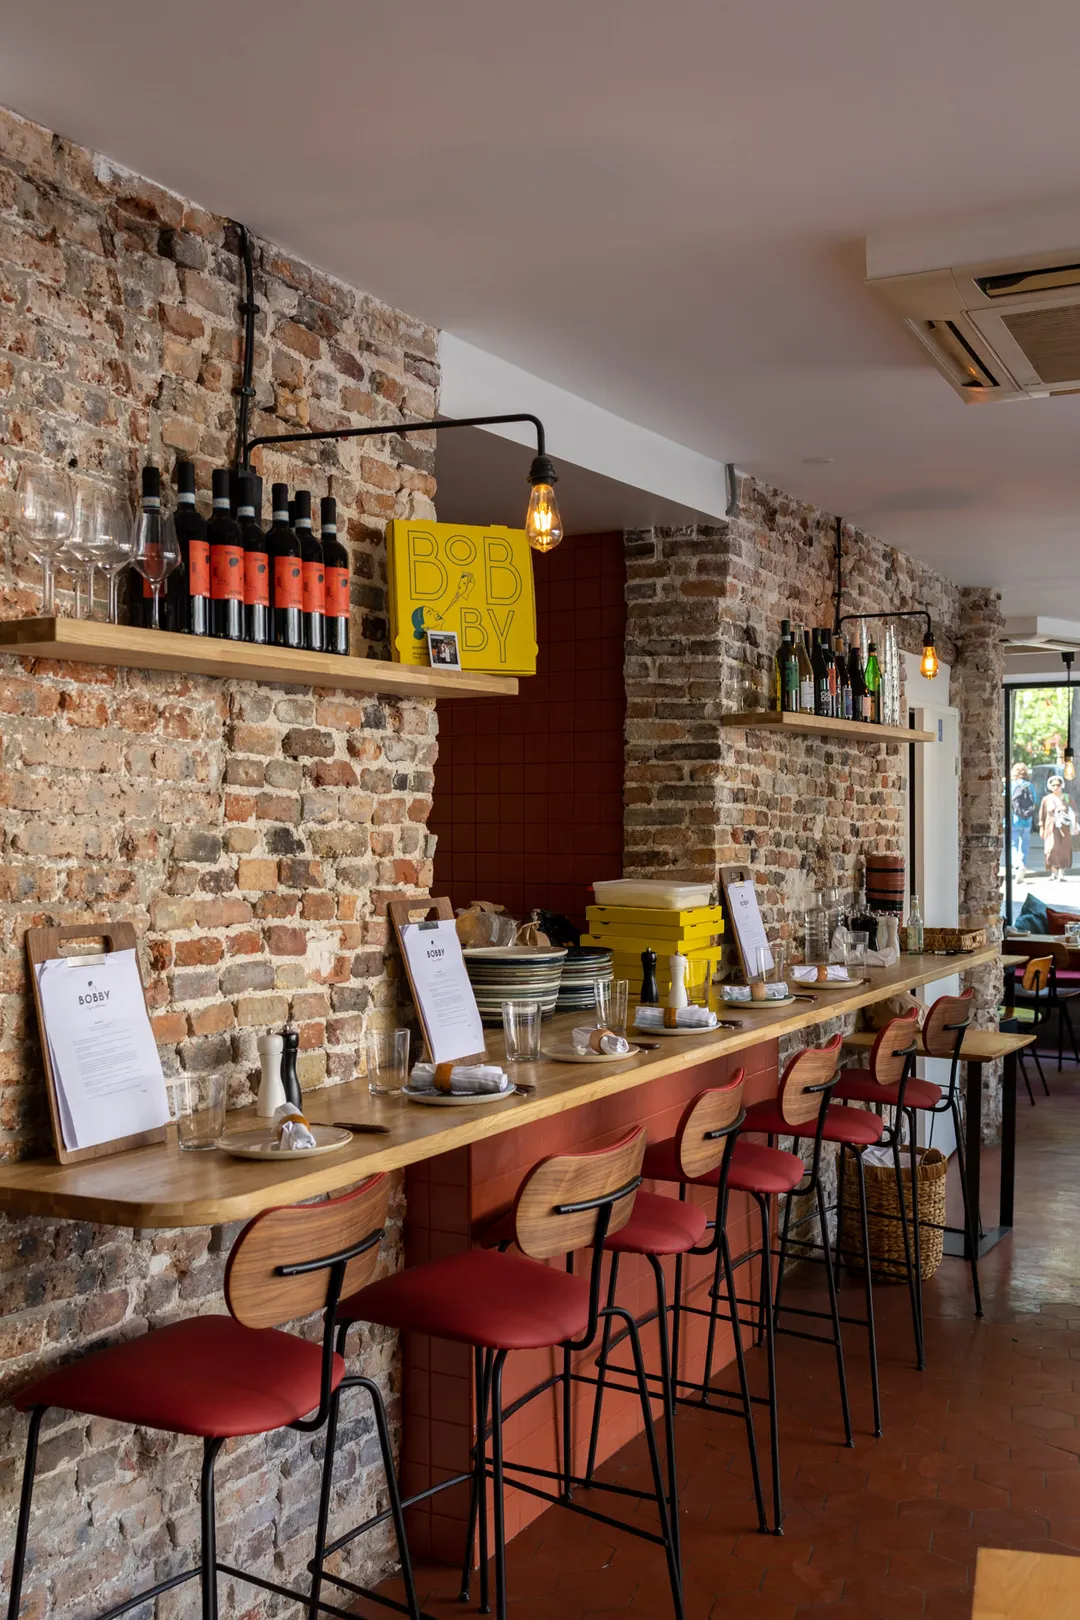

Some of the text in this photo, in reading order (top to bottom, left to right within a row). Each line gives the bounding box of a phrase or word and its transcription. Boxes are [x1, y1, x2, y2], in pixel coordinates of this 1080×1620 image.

[407, 530, 523, 606] BOB
[460, 607, 515, 663] BY
[426, 949, 445, 958] BOBBY
[78, 990, 110, 1005] BOBBY
